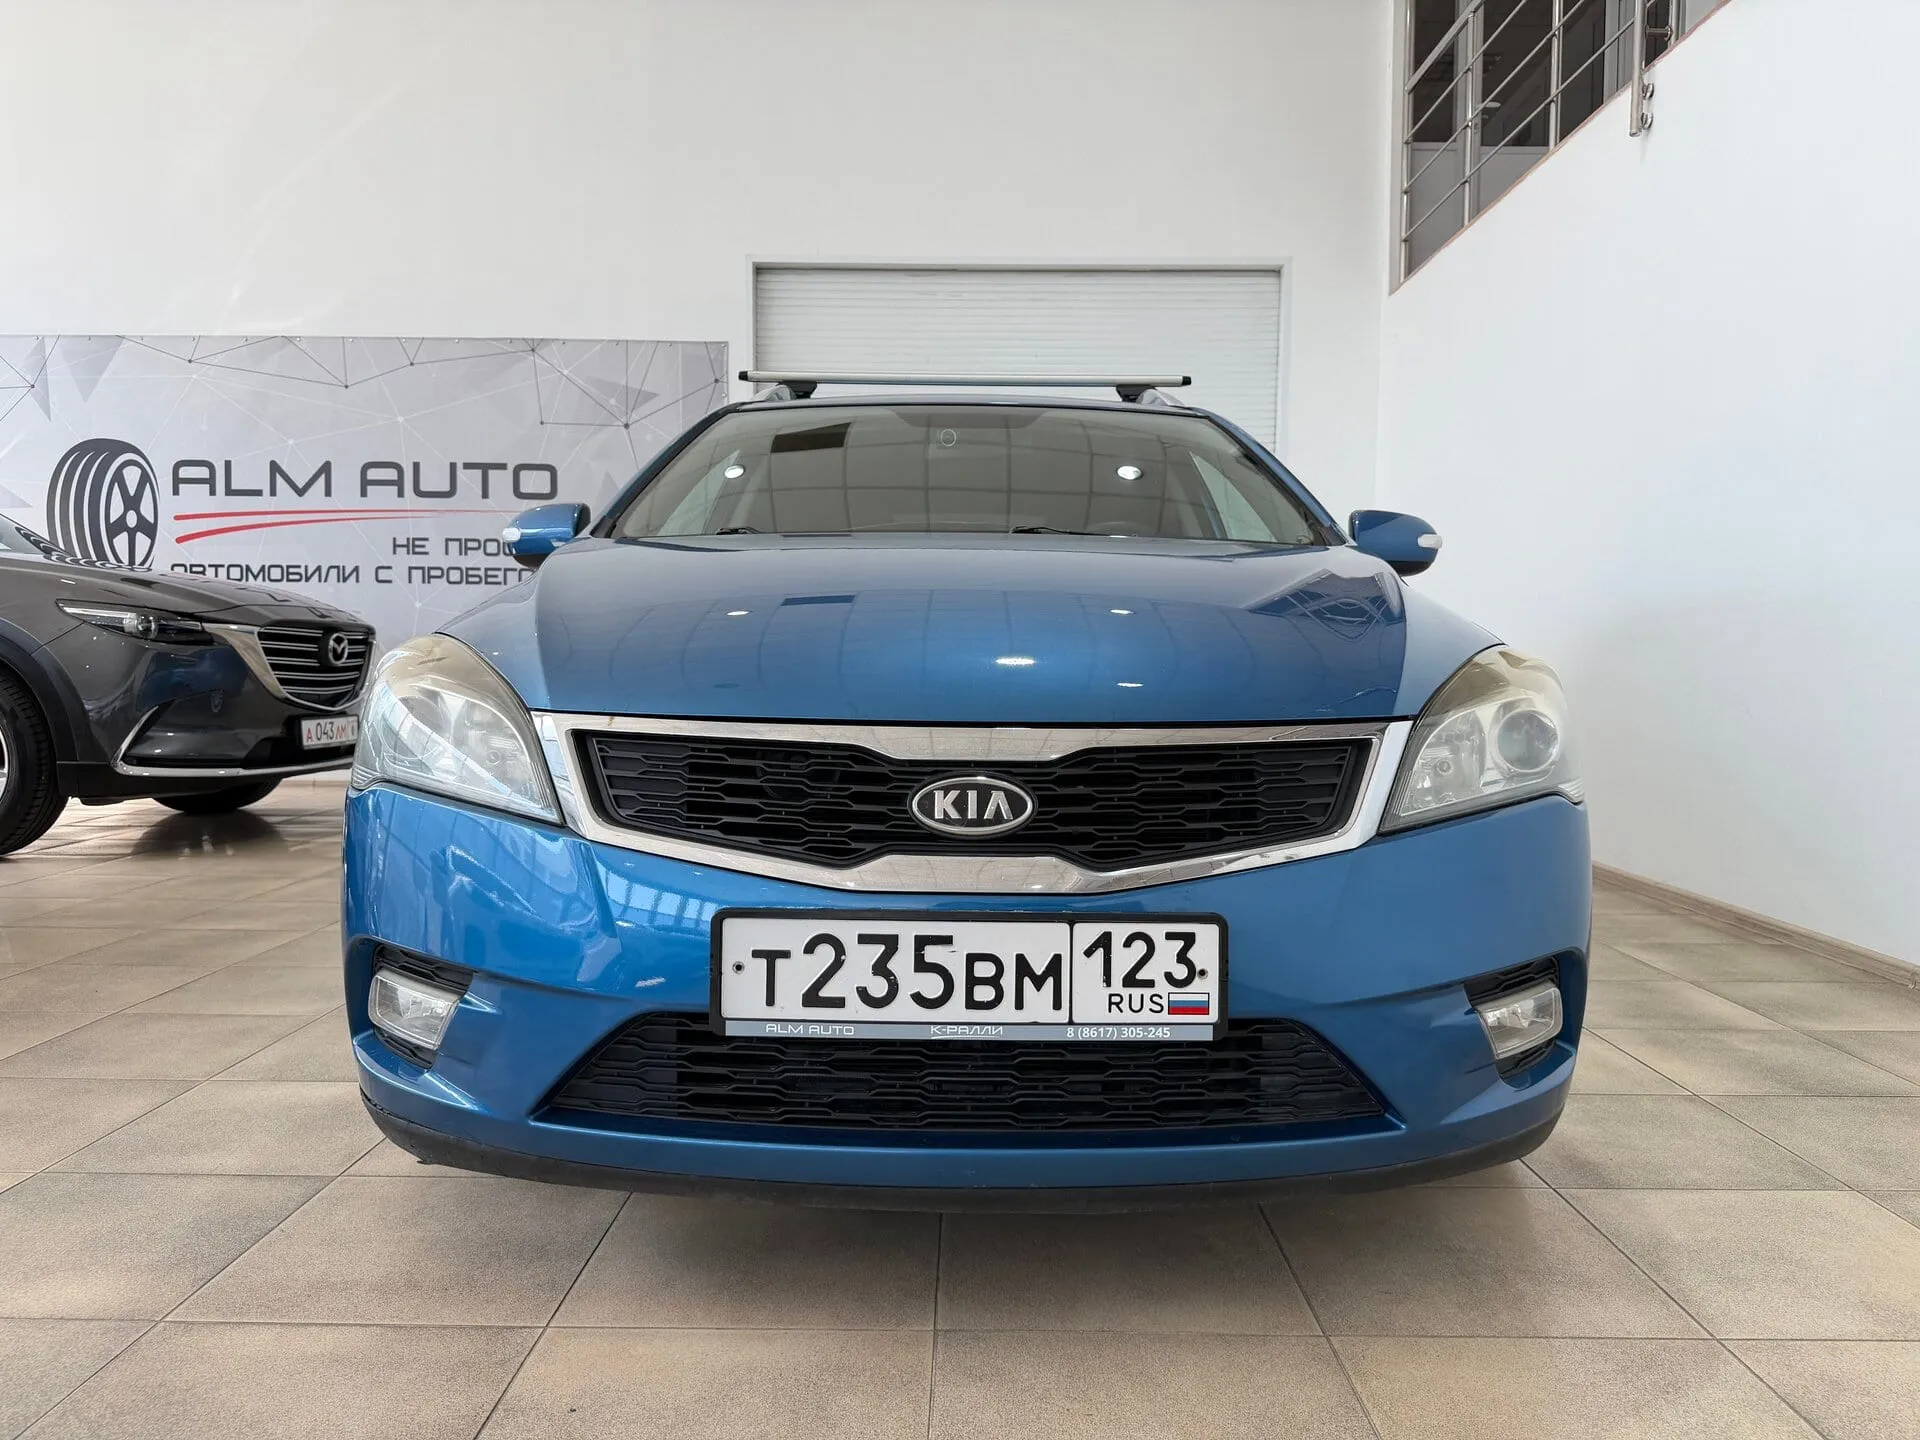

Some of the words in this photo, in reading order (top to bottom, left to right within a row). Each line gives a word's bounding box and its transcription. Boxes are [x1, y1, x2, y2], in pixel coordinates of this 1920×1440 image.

[172, 459, 332, 497] ALM
[360, 461, 558, 500] AUTO
[392, 537, 430, 555] НЕ
[374, 566, 393, 584] С
[934, 790, 1014, 820] KIA
[751, 933, 1063, 1011] Т235ВМ
[1083, 931, 1197, 988] 123
[1108, 993, 1164, 1013] RUS
[765, 1023, 804, 1035] ALM
[808, 1025, 855, 1036] AUTO
[1066, 1027, 1074, 1038] 8
[1077, 1026, 1117, 1040] (8617)
[1121, 1027, 1171, 1039] 305-245
